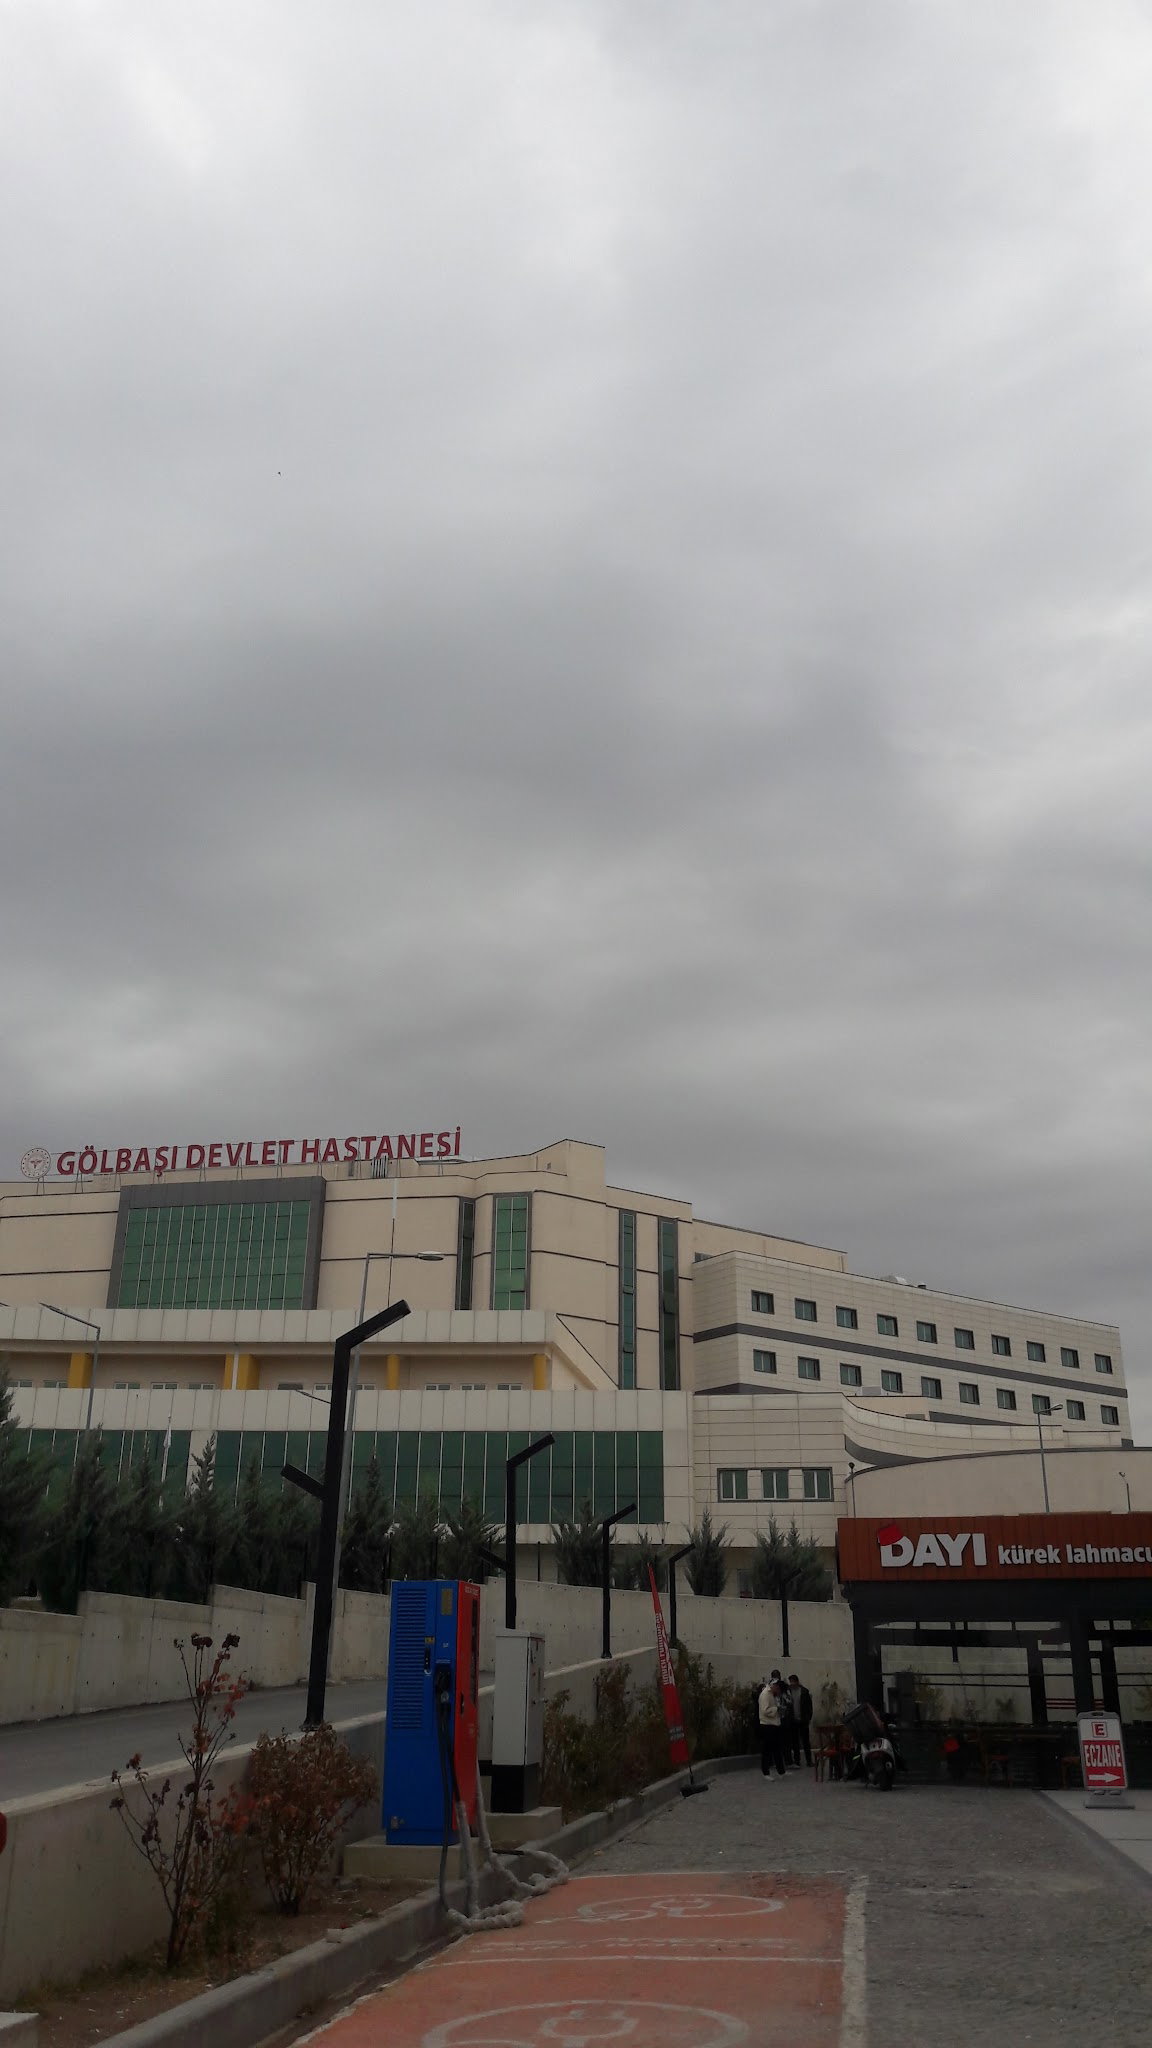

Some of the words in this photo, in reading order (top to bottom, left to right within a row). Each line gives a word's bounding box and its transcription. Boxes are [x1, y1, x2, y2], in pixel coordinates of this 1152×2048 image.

[56, 1145, 178, 1177] GÖLBAŞI
[186, 1139, 295, 1169] DEVLET
[301, 1126, 461, 1163] HASTANESİ
[879, 1532, 987, 1567] DAYI
[998, 1544, 1061, 1565] kürek
[1094, 1723, 1105, 1736] E
[1084, 1744, 1122, 1768] ECZANE
